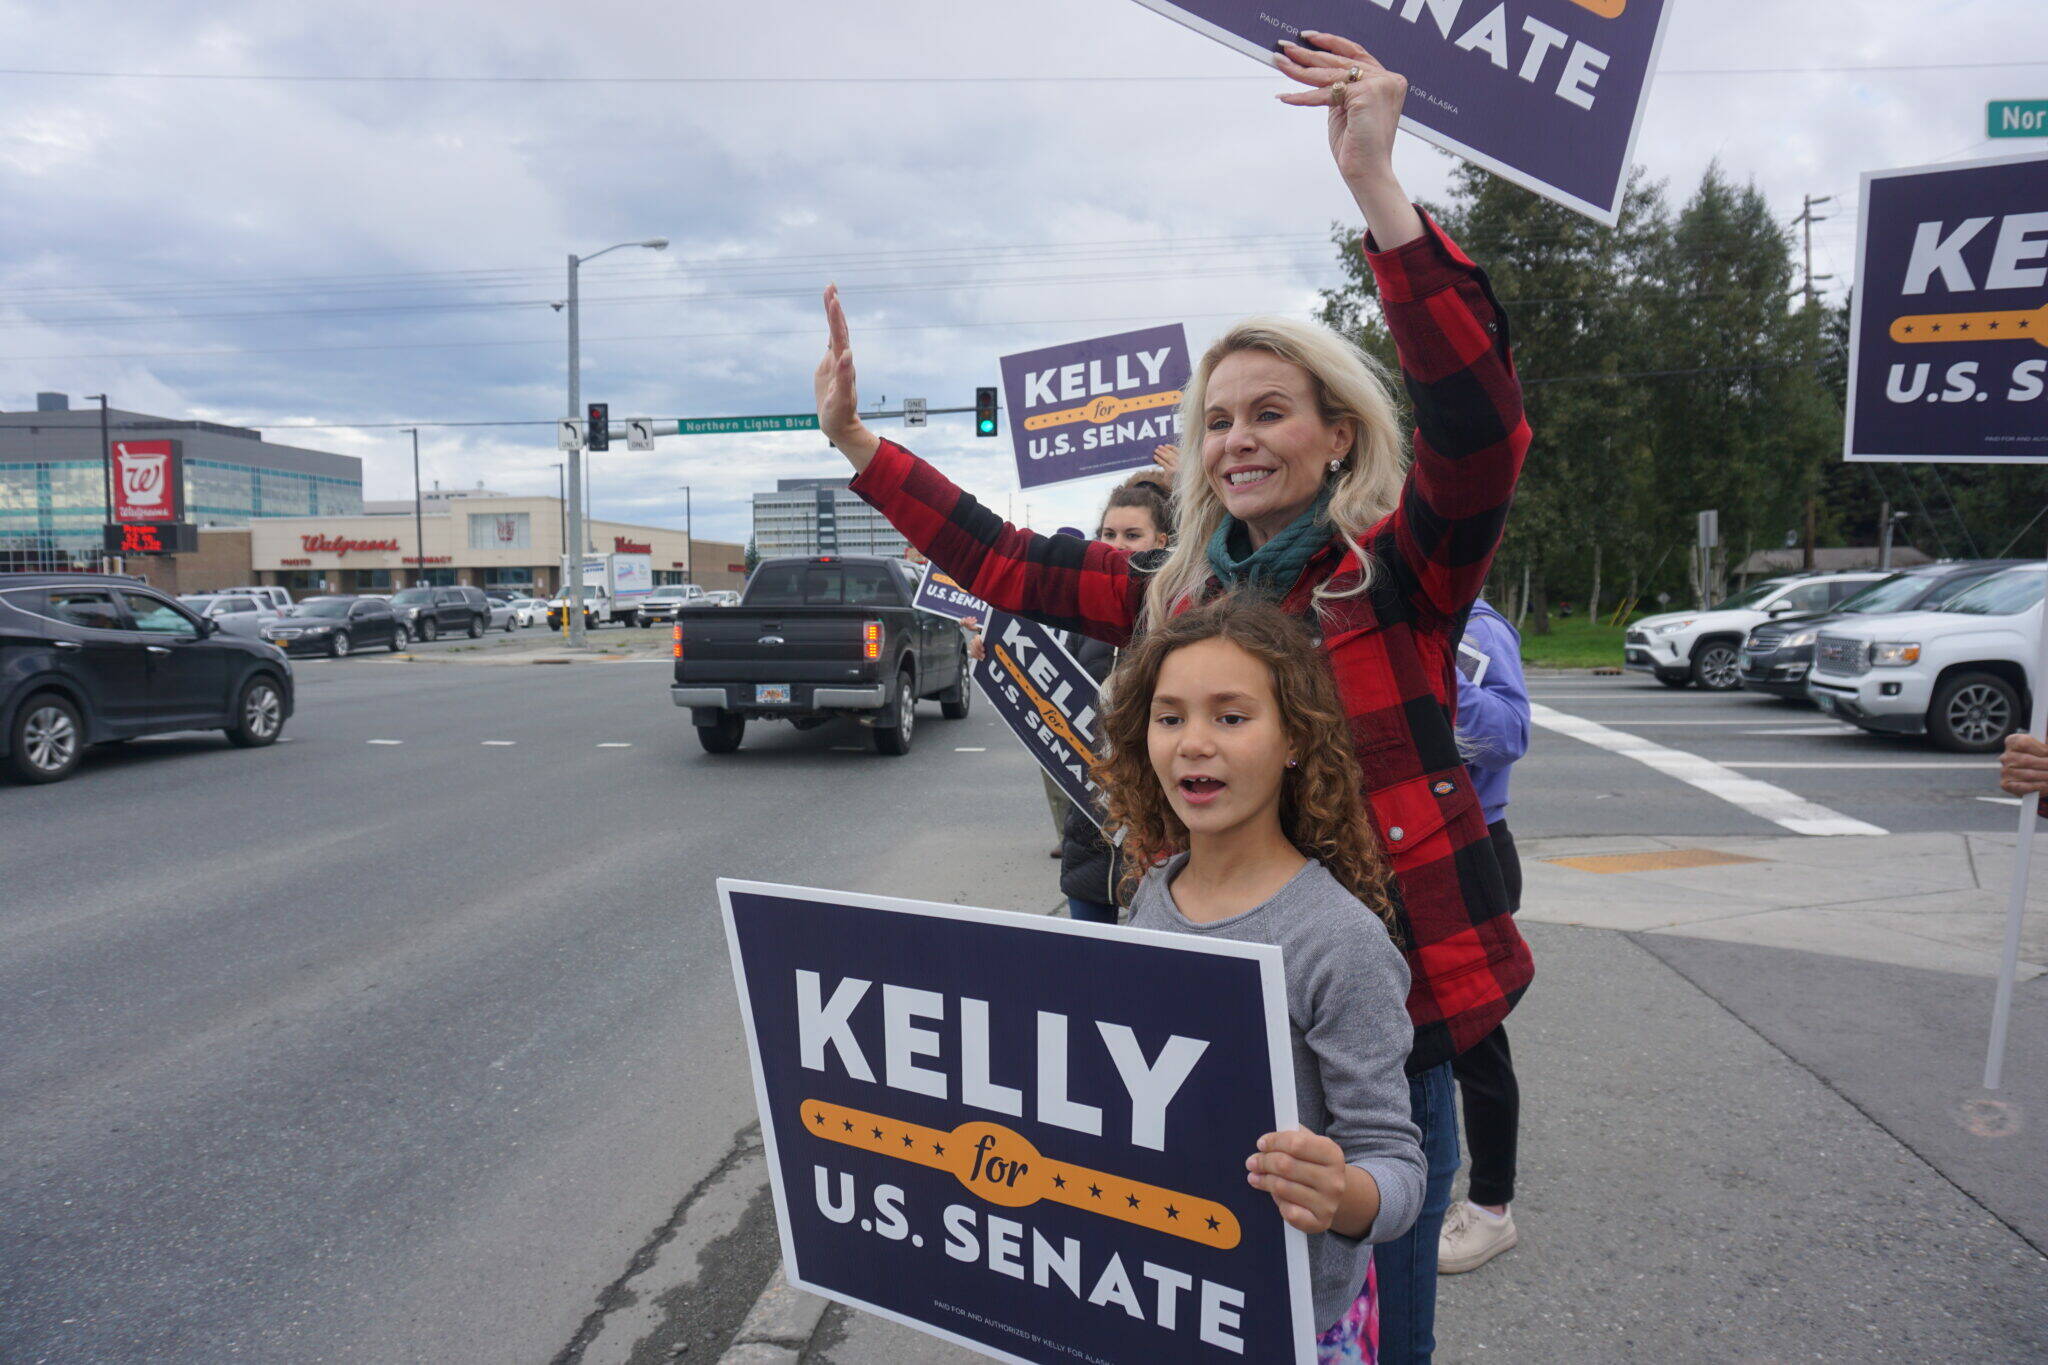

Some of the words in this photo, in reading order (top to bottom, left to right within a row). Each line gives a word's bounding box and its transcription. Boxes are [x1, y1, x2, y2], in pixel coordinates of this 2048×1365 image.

[1260, 12, 1280, 27] PAID
[1281, 22, 1299, 36] FOR
[1409, 85, 1427, 99] FOR
[1427, 94, 1459, 114] ALASKA
[1369, 0, 1611, 111] NATE
[1902, 211, 2048, 296] KE
[1024, 346, 1171, 408] KELLY
[1886, 361, 1989, 403] U.S.
[686, 421, 739, 432] Northern
[744, 418, 780, 430] Lights
[785, 418, 813, 429] Blvd
[1094, 400, 1116, 419] for
[1029, 432, 1076, 460] U.S.
[301, 533, 400, 558] Walgreens
[926, 584, 947, 600] U.S.
[1002, 618, 1097, 743] KELL
[988, 659, 1020, 711] U.S.
[1024, 709, 1098, 792] SENA
[1042, 709, 1064, 730] for
[795, 968, 1211, 1152] KELLY
[969, 1134, 1029, 1188] for
[813, 1164, 924, 1249] U.S.
[943, 1204, 1246, 1355] SENATE
[934, 1300, 950, 1311] PAID
[951, 1306, 966, 1316] FOR
[967, 1312, 983, 1322] AND
[984, 1317, 1030, 1340] AUTHORIZED
[1031, 1334, 1042, 1344] BY
[1043, 1338, 1065, 1352] KELLY
[1067, 1346, 1083, 1359] FOR
